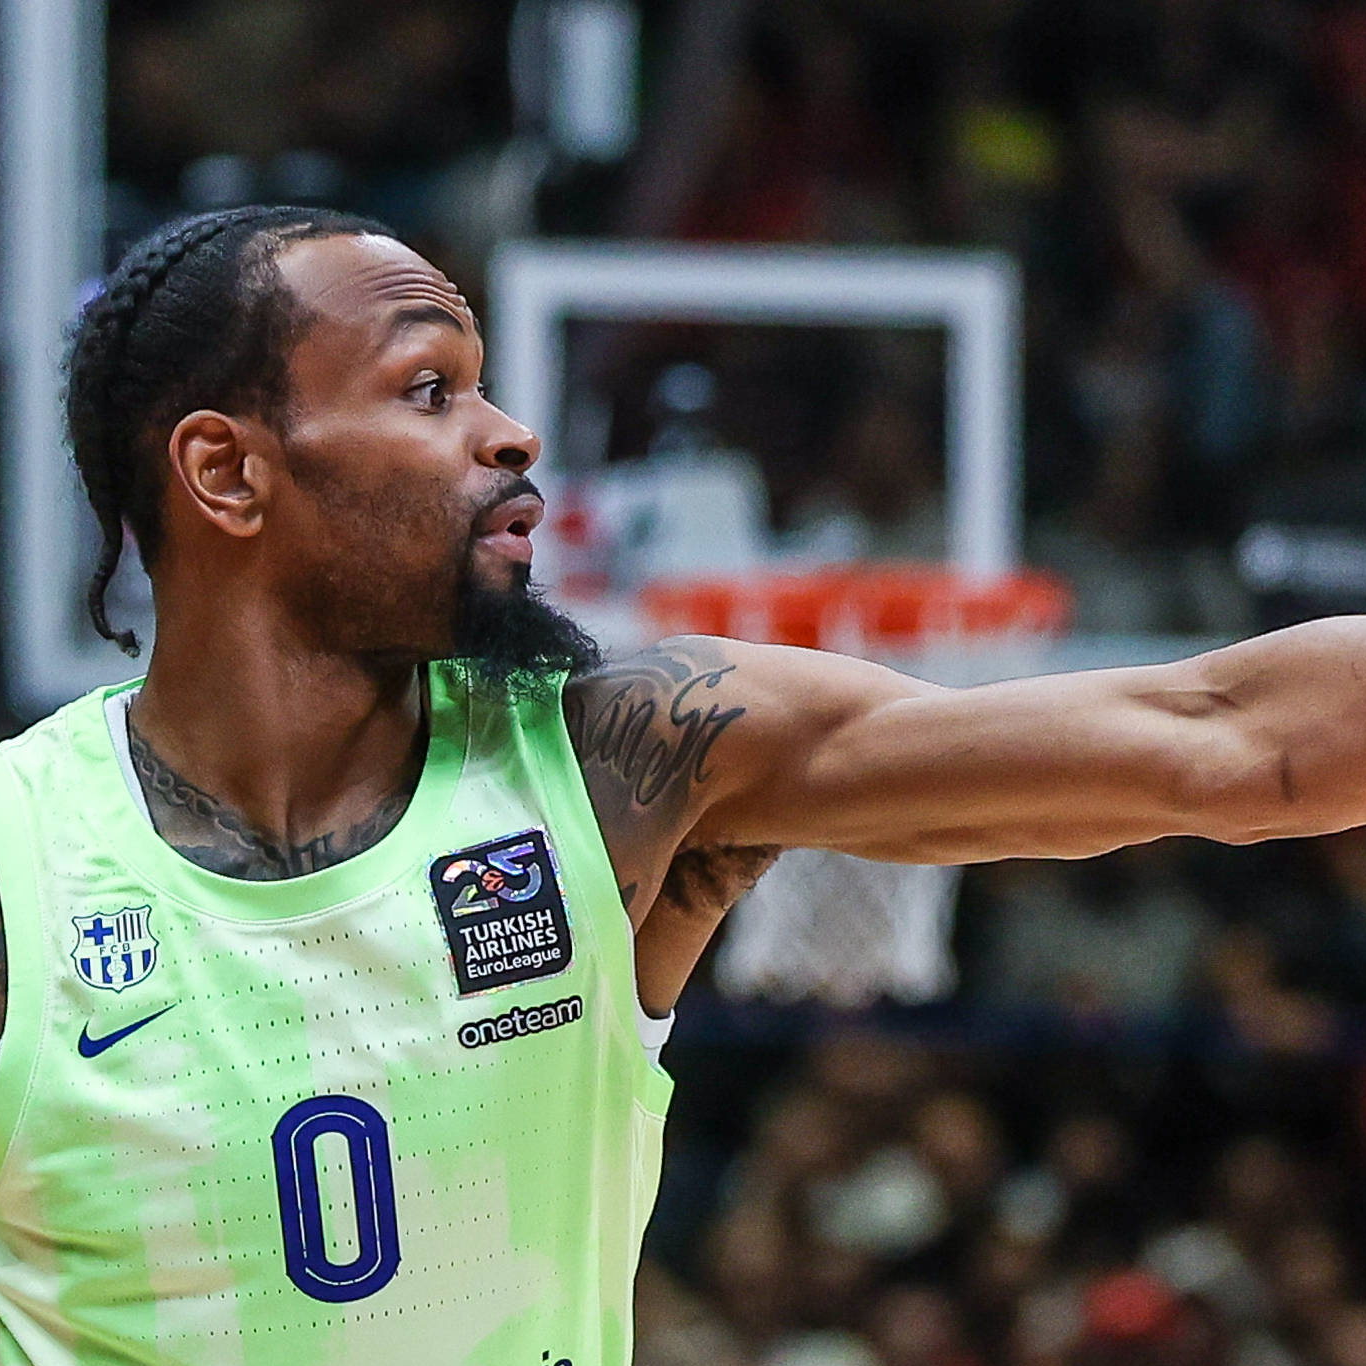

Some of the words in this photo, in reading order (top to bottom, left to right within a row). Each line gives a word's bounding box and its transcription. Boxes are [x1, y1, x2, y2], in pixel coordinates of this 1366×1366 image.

[459, 909, 554, 945] TURKISH
[465, 927, 558, 963] AIRLINES
[467, 947, 561, 979] EuroLeague
[460, 997, 582, 1048] oneteam
[271, 1095, 402, 1303] 0
